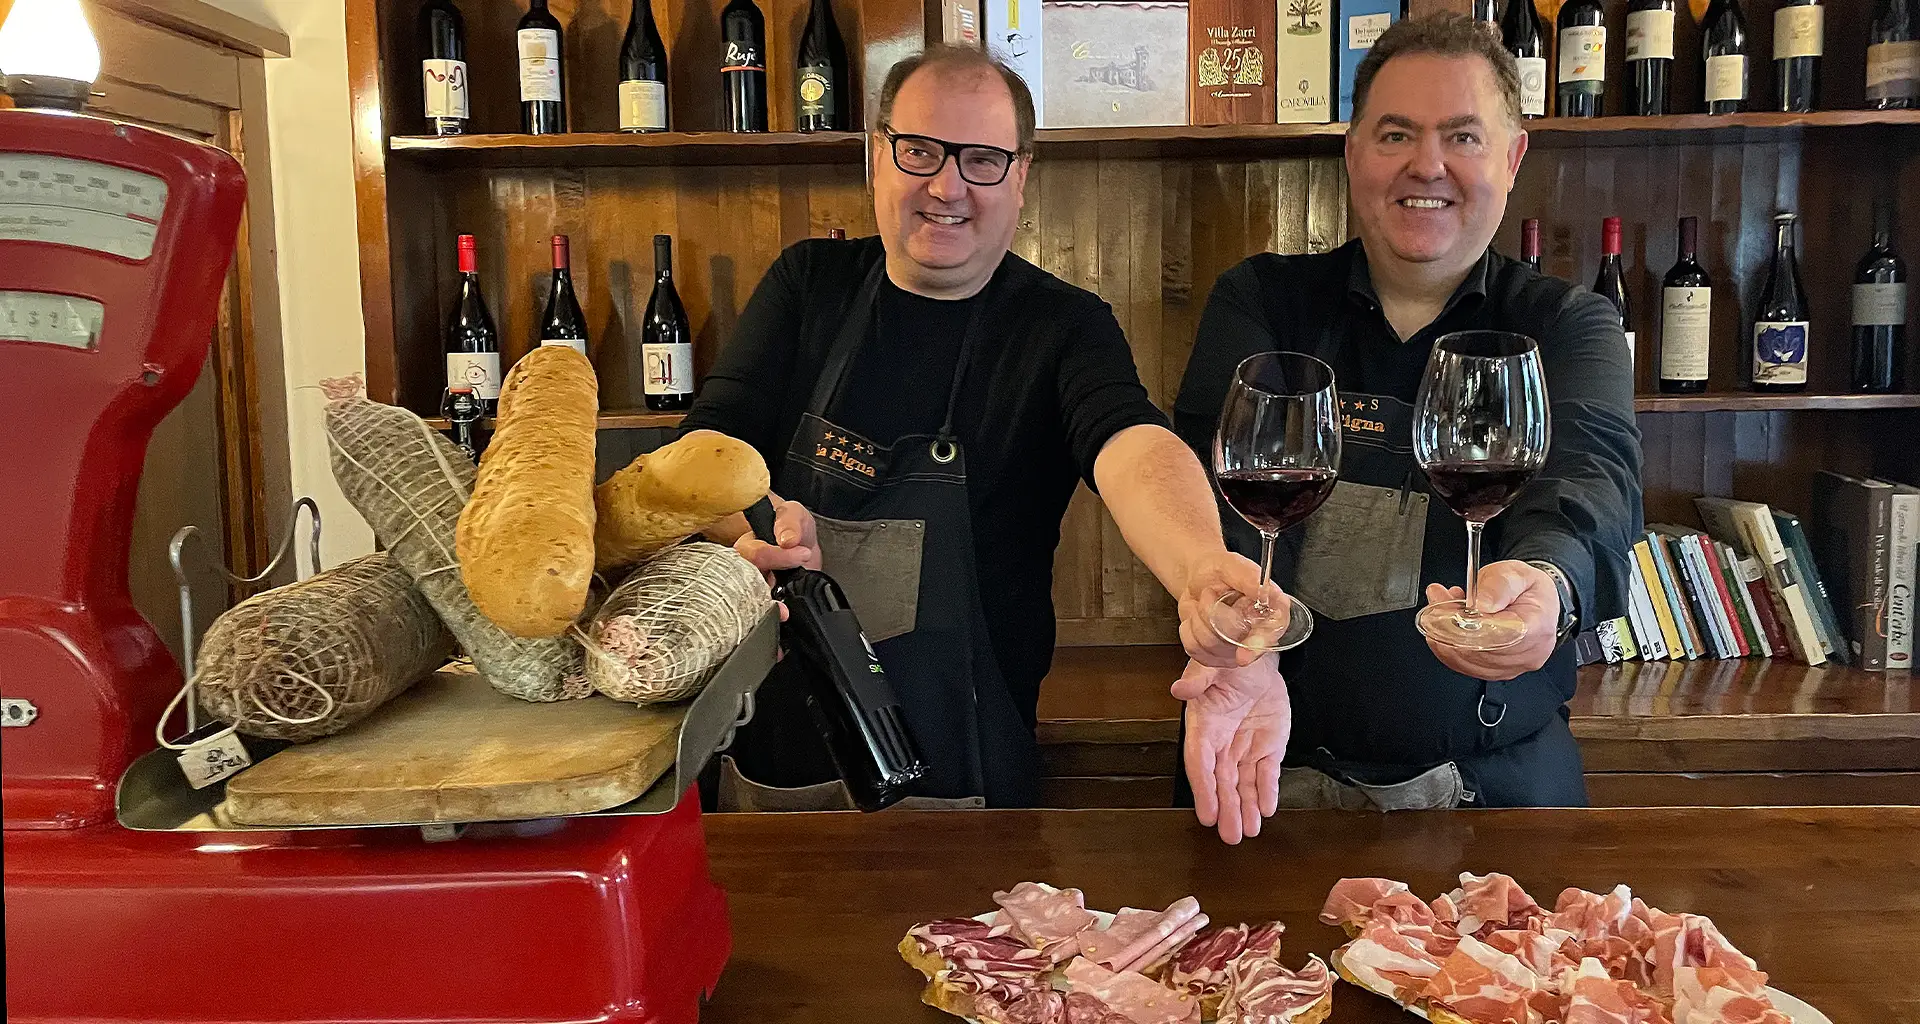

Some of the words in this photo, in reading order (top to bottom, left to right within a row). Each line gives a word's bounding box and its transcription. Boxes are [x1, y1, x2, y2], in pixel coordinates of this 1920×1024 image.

[1207, 26, 1229, 38] Villa
[1231, 26, 1256, 38] Zarri
[1221, 47, 1241, 71] 25
[1370, 398, 1379, 411] S
[1341, 414, 1386, 432] igna
[829, 447, 876, 477] Pigna
